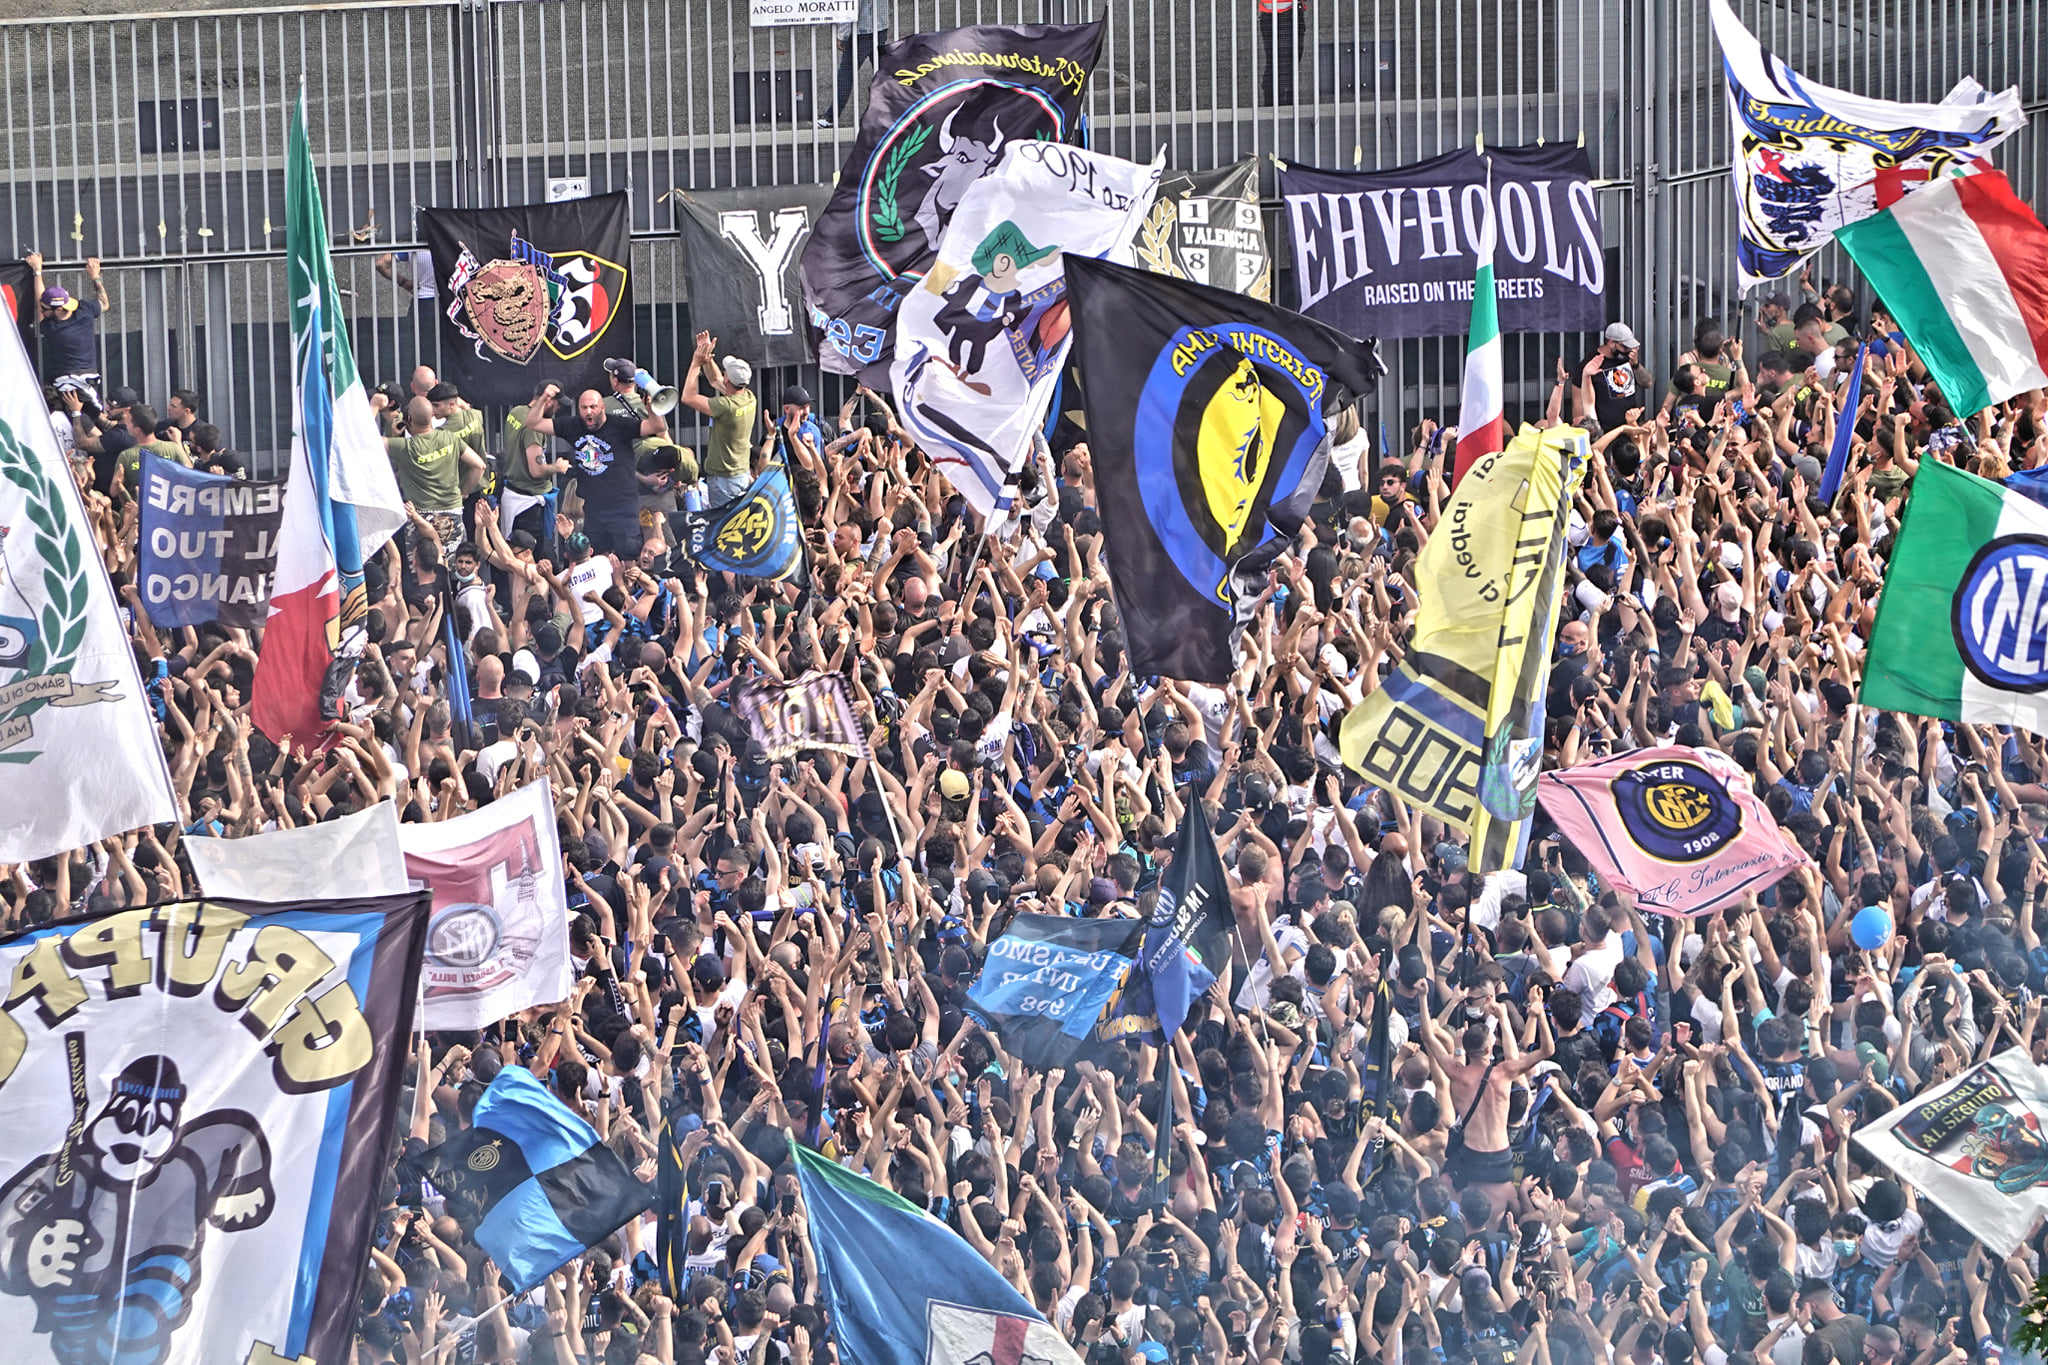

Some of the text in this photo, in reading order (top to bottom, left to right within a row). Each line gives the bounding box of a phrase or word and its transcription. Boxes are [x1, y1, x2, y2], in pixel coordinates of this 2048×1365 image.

[752, 1, 855, 14] ANGELO MORATTI
[1189, 204, 1256, 225] 1 9
[1183, 226, 1260, 251] VALENCIA
[1284, 180, 1604, 314] EHV-HOOLS
[718, 204, 810, 336] Y
[1189, 253, 1254, 276] 8 3
[1364, 278, 1544, 306] RAISED ON THE TREETS
[418, 443, 454, 464] STAFF
[782, 492, 798, 545] INTER
[1683, 832, 1720, 854] 1908
[1920, 1084, 1976, 1122] BECERI
[1921, 1085, 2003, 1148] AL SEGUITO
